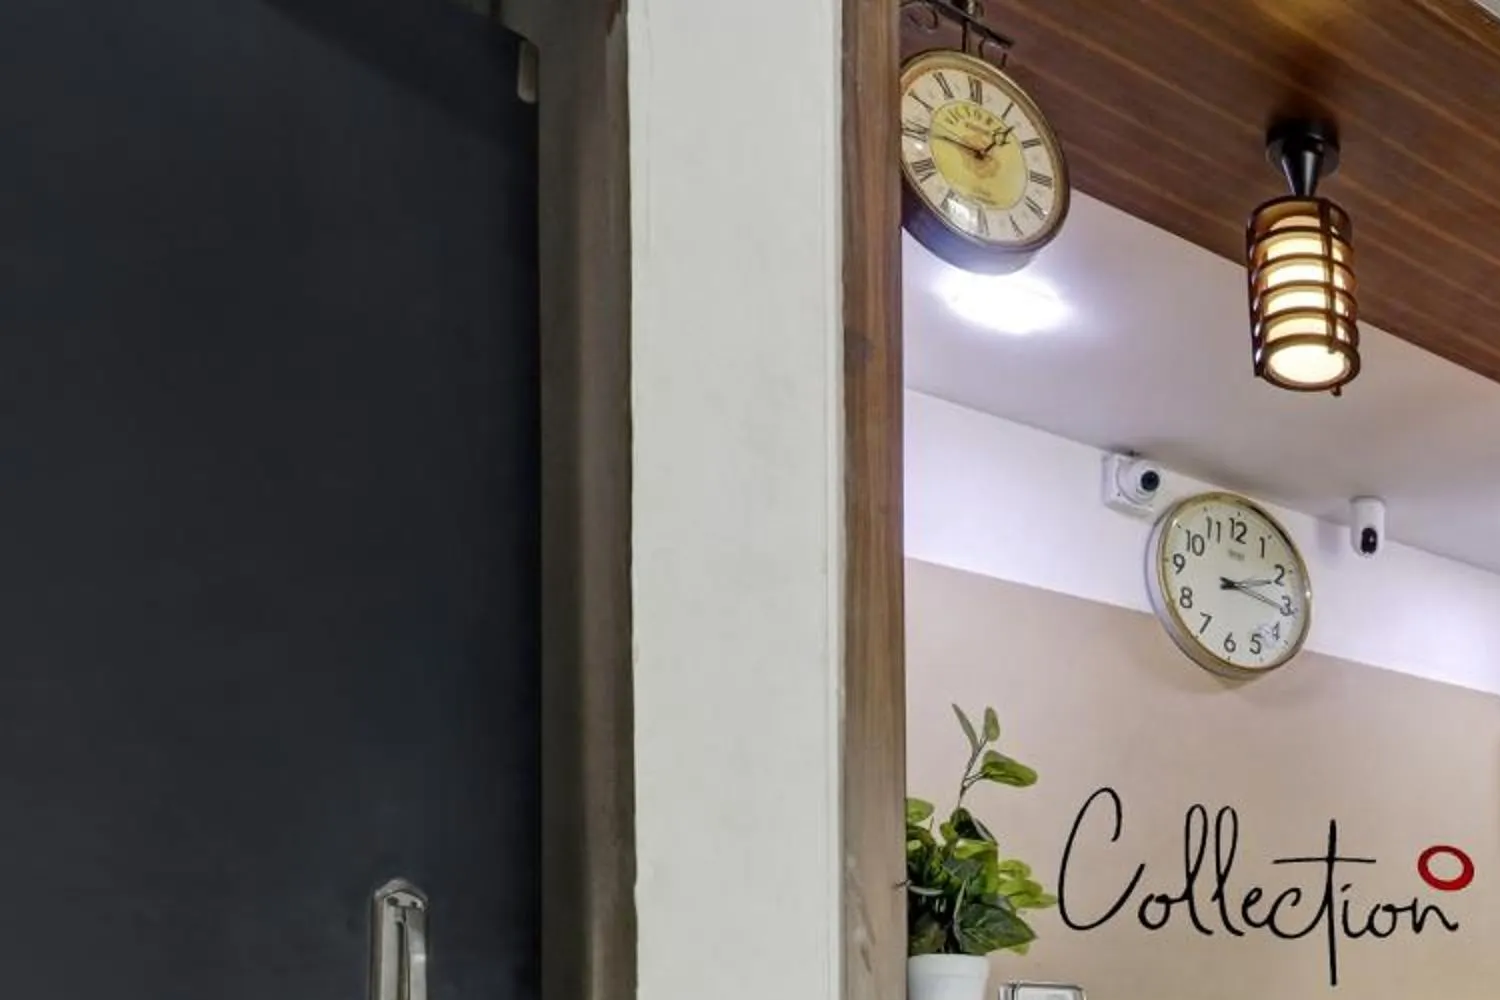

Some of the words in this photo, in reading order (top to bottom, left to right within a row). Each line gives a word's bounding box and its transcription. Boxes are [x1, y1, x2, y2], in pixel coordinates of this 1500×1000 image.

[1205, 516, 1222, 544] 11
[1229, 517, 1249, 545] 12
[1185, 529, 1206, 556] 10
[1258, 535, 1267, 559] 1
[1172, 553, 1186, 575] 9
[1273, 563, 1286, 587] 2
[1179, 586, 1193, 609] 8
[1279, 595, 1293, 617] 3
[1199, 611, 1213, 634] 7
[1223, 631, 1237, 653] 6
[1249, 633, 1263, 655] 5
[1057, 787, 1459, 986] Collection
